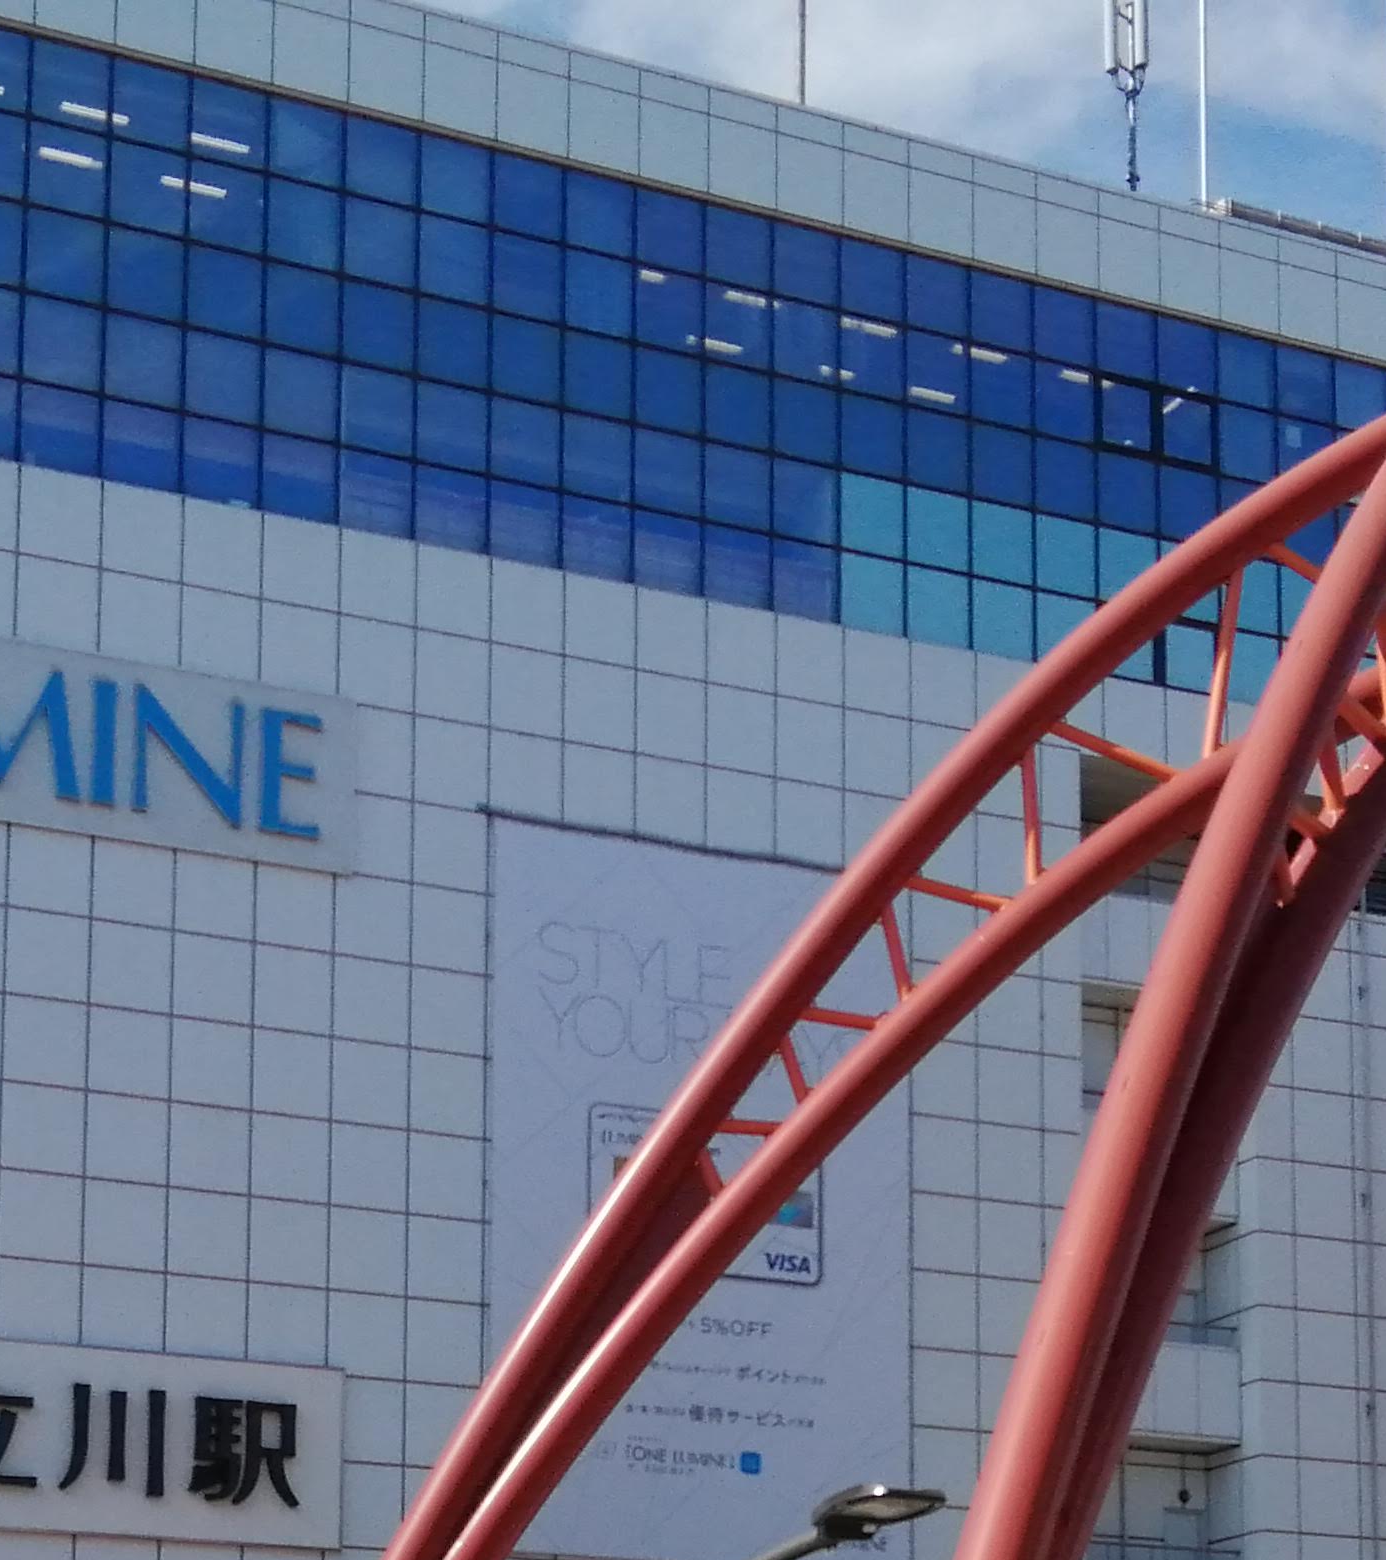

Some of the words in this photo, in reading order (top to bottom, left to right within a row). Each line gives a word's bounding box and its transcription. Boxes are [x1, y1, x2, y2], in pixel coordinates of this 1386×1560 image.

[537, 921, 733, 1010] STYLE
[537, 984, 710, 1065] YOUR
[764, 1252, 811, 1275] VISA
[700, 1316, 774, 1338] 5%OFF
